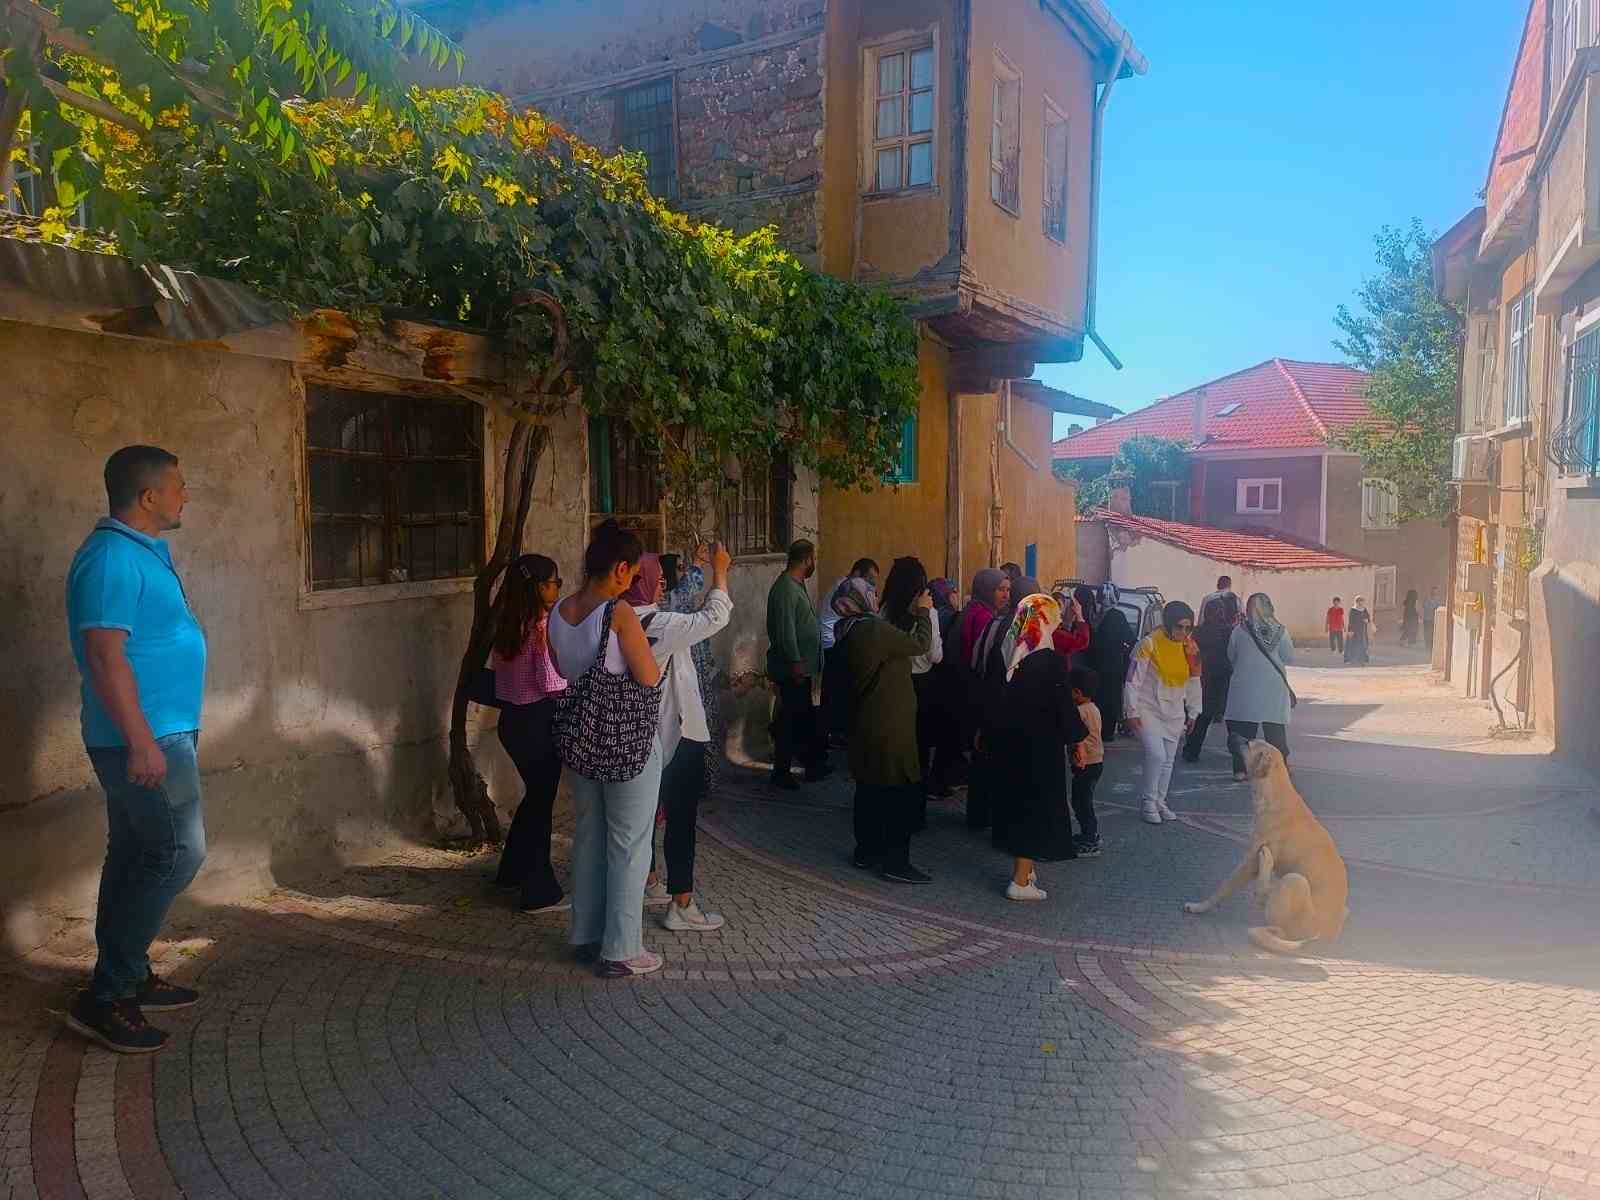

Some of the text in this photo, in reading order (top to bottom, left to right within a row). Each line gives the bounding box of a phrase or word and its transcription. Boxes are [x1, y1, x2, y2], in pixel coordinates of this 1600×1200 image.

[619, 722, 637, 733] BAG
[600, 736, 617, 745] BAG
[611, 744, 630, 755] THE
[591, 756, 623, 767] SHAKA
[626, 752, 643, 763] THE
